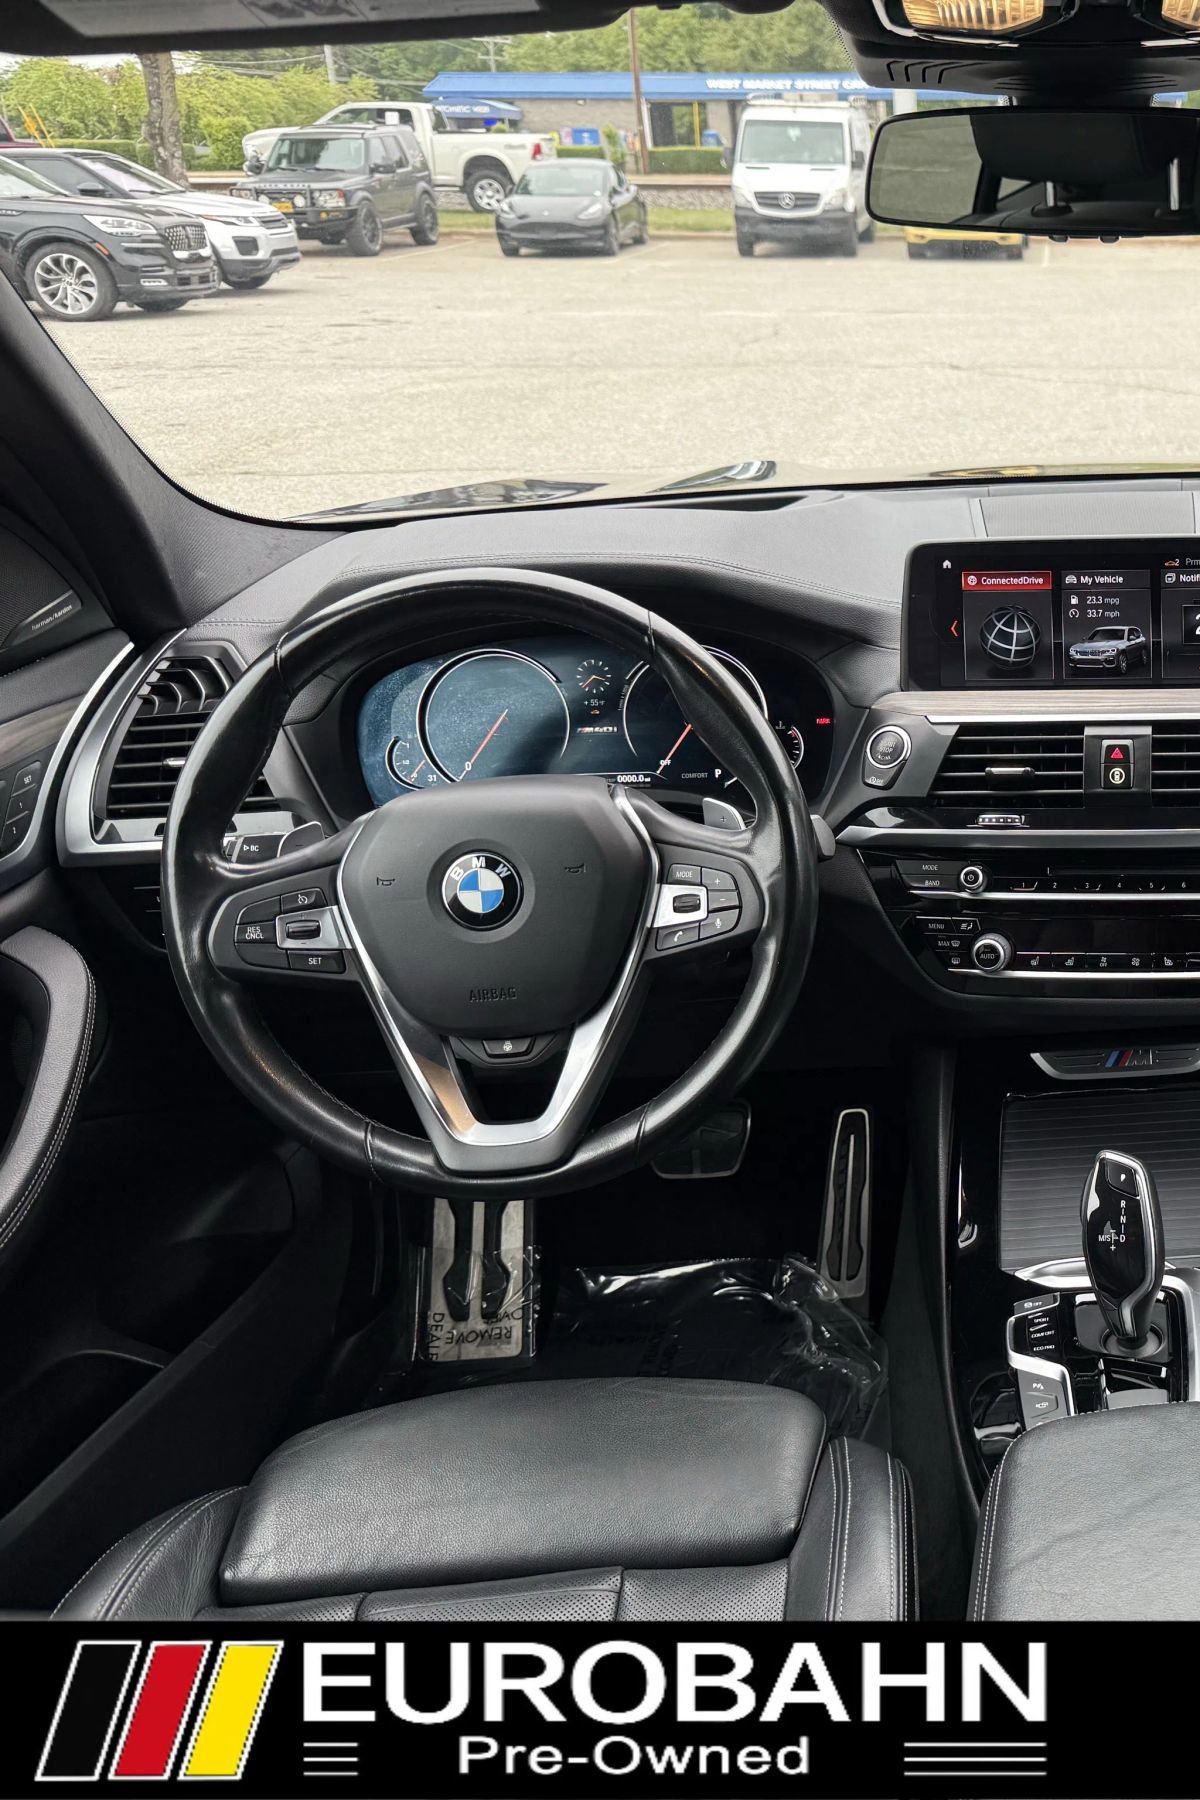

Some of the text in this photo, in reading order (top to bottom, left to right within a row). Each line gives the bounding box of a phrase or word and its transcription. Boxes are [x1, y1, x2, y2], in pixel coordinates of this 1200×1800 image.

[706, 79, 740, 89] WEST
[743, 79, 791, 89] MARKET
[795, 79, 839, 89] STREET
[981, 576, 1044, 585] ConnectedDrive
[1080, 575, 1124, 586] My Vehicle
[1086, 596, 1120, 606] 23.3 mpg
[31, 604, 73, 631] harman/kardon
[1086, 609, 1120, 619] 33.7 mph
[427, 774, 437, 782] 31
[714, 768, 722, 778] P
[450, 856, 511, 881] BMW
[245, 932, 264, 940] CNCL
[308, 957, 322, 965] SET
[469, 987, 518, 1003] AIRBAG
[1120, 1199, 1127, 1209] R
[1120, 1215, 1127, 1224] N
[1119, 1234, 1127, 1243] D
[445, 1326, 513, 1345] REMOVE
[1031, 1329, 1055, 1339] COMFORT
